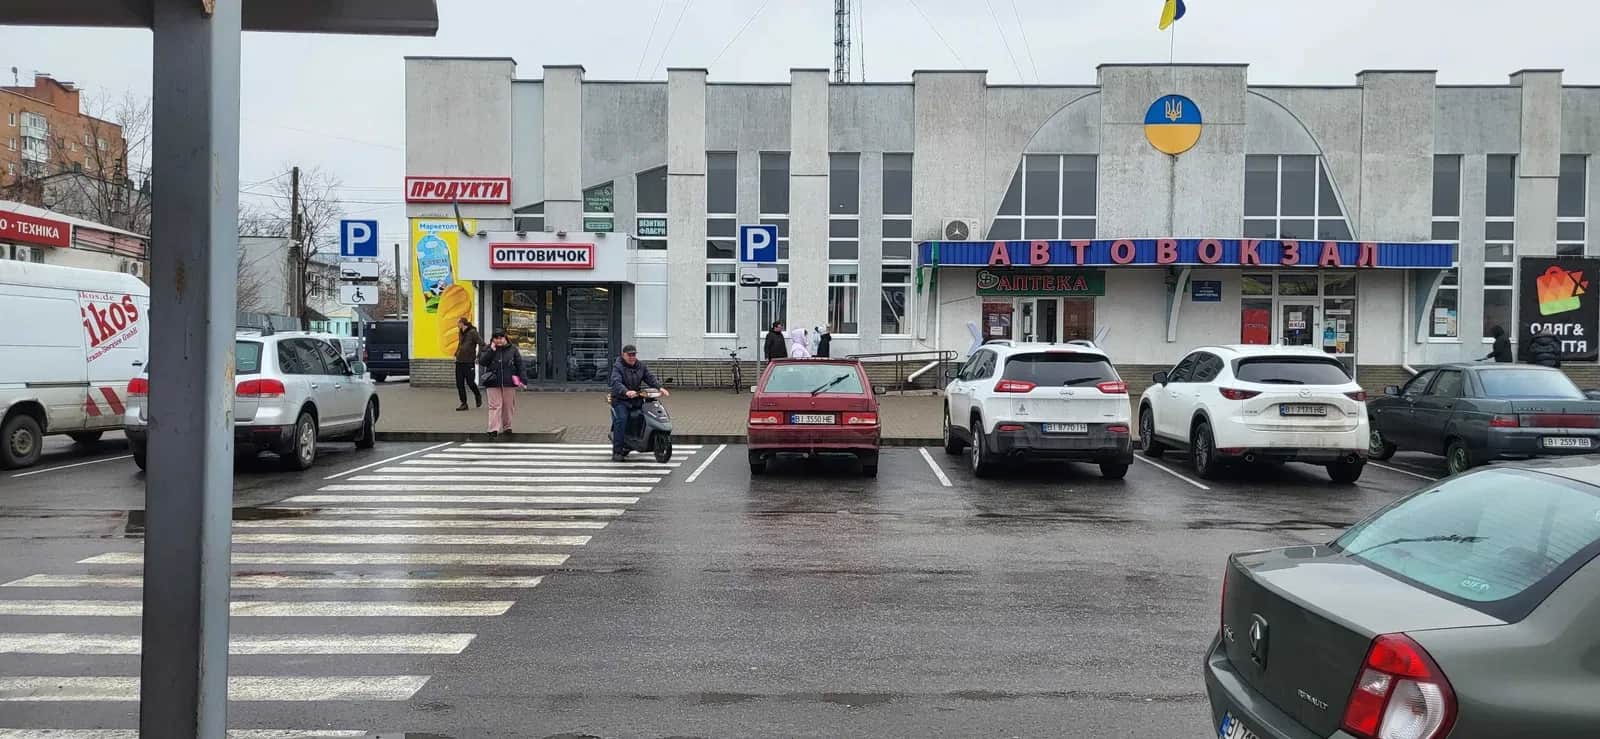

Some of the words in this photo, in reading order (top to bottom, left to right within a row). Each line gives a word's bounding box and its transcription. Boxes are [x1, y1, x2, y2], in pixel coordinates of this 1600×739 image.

[410, 181, 504, 199] ПРОДУКТИ
[16, 221, 60, 239] ТЕХНІКА
[347, 222, 371, 255] P
[496, 249, 587, 262] ОПТОВИЧОК
[747, 228, 770, 260] P
[988, 238, 1378, 267] АВТОВОКЗАЛ
[997, 274, 1089, 291] АПТЕКА
[80, 294, 139, 348] ikos
